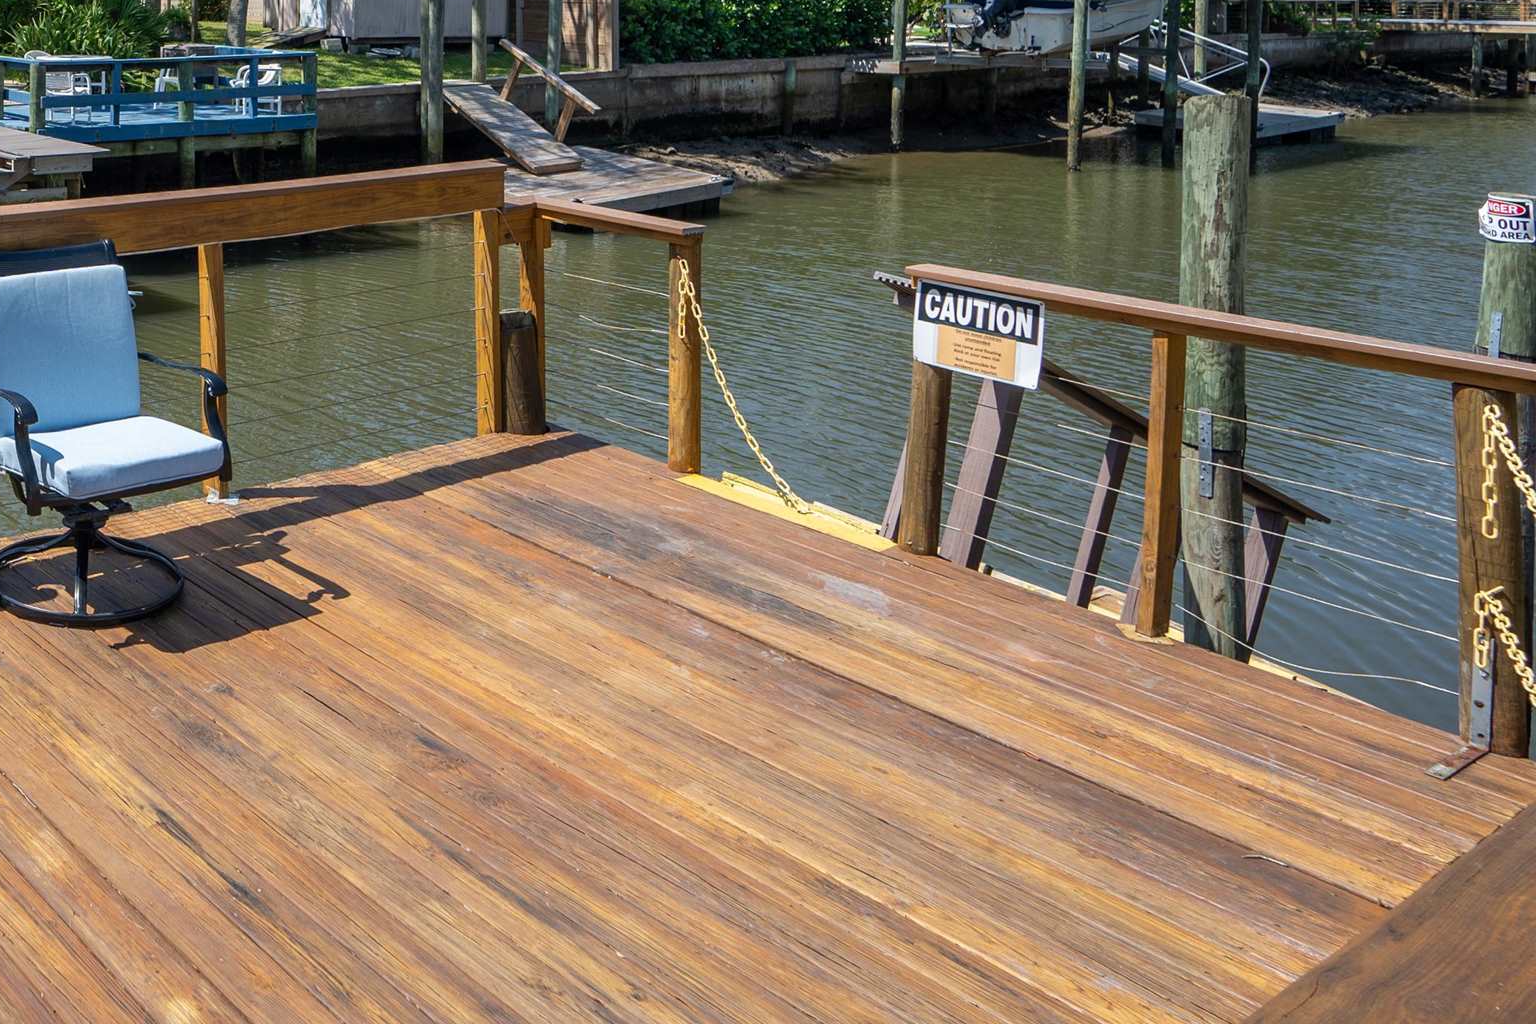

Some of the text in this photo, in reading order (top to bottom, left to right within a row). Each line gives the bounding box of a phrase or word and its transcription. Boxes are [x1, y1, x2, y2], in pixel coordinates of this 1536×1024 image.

[1498, 218, 1530, 231] OUT
[1500, 231, 1531, 240] AREA
[925, 288, 1033, 339] CAUTION
